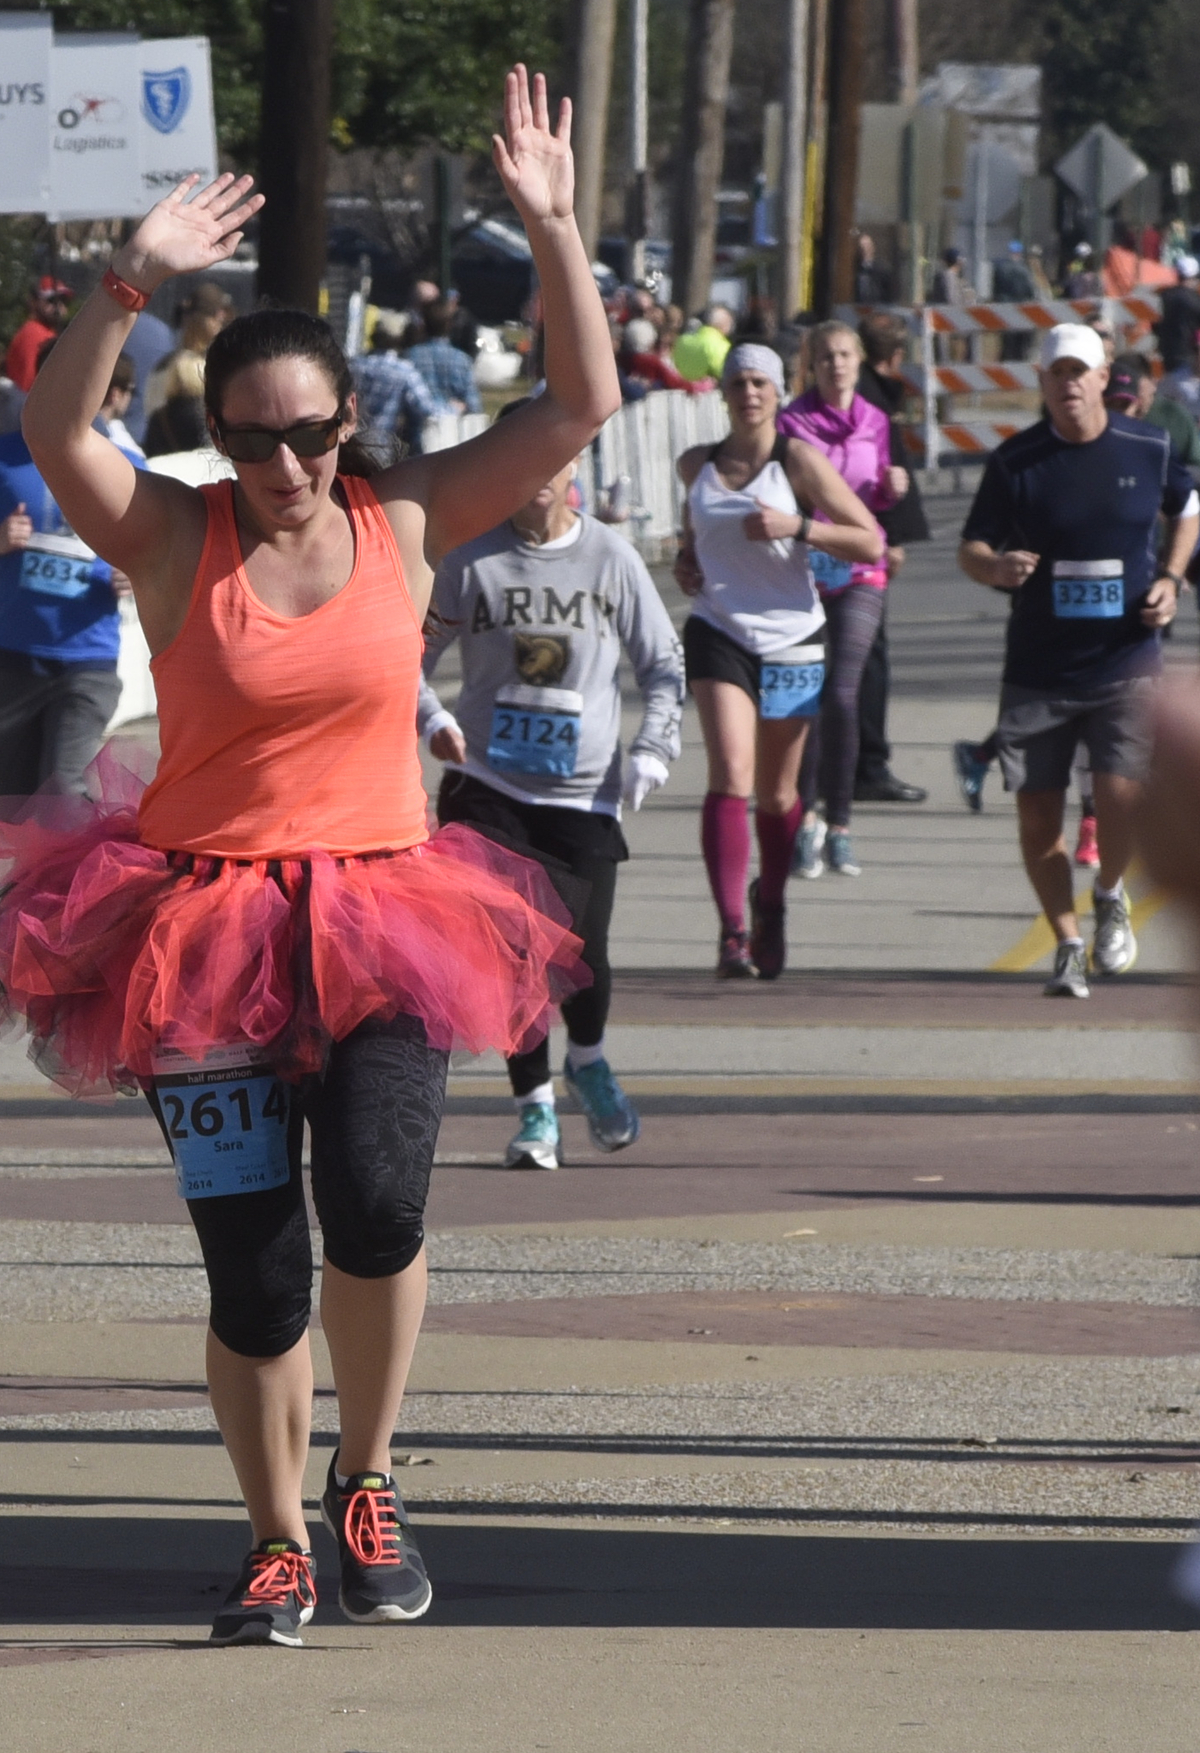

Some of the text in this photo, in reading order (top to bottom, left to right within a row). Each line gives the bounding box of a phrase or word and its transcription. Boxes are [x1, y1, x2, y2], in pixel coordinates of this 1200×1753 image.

[53, 136, 126, 152] Logistics
[26, 555, 90, 584] 2634
[1057, 583, 1120, 604] 3238
[767, 668, 824, 689] 2959
[496, 714, 577, 746] 2124
[187, 1069, 253, 1083] half marathon
[163, 1083, 288, 1140] 2614
[213, 1140, 244, 1153] Sara
[187, 1179, 213, 1191] 2614
[239, 1173, 266, 1186] 2614
[362, 1478, 383, 1489] NIKE
